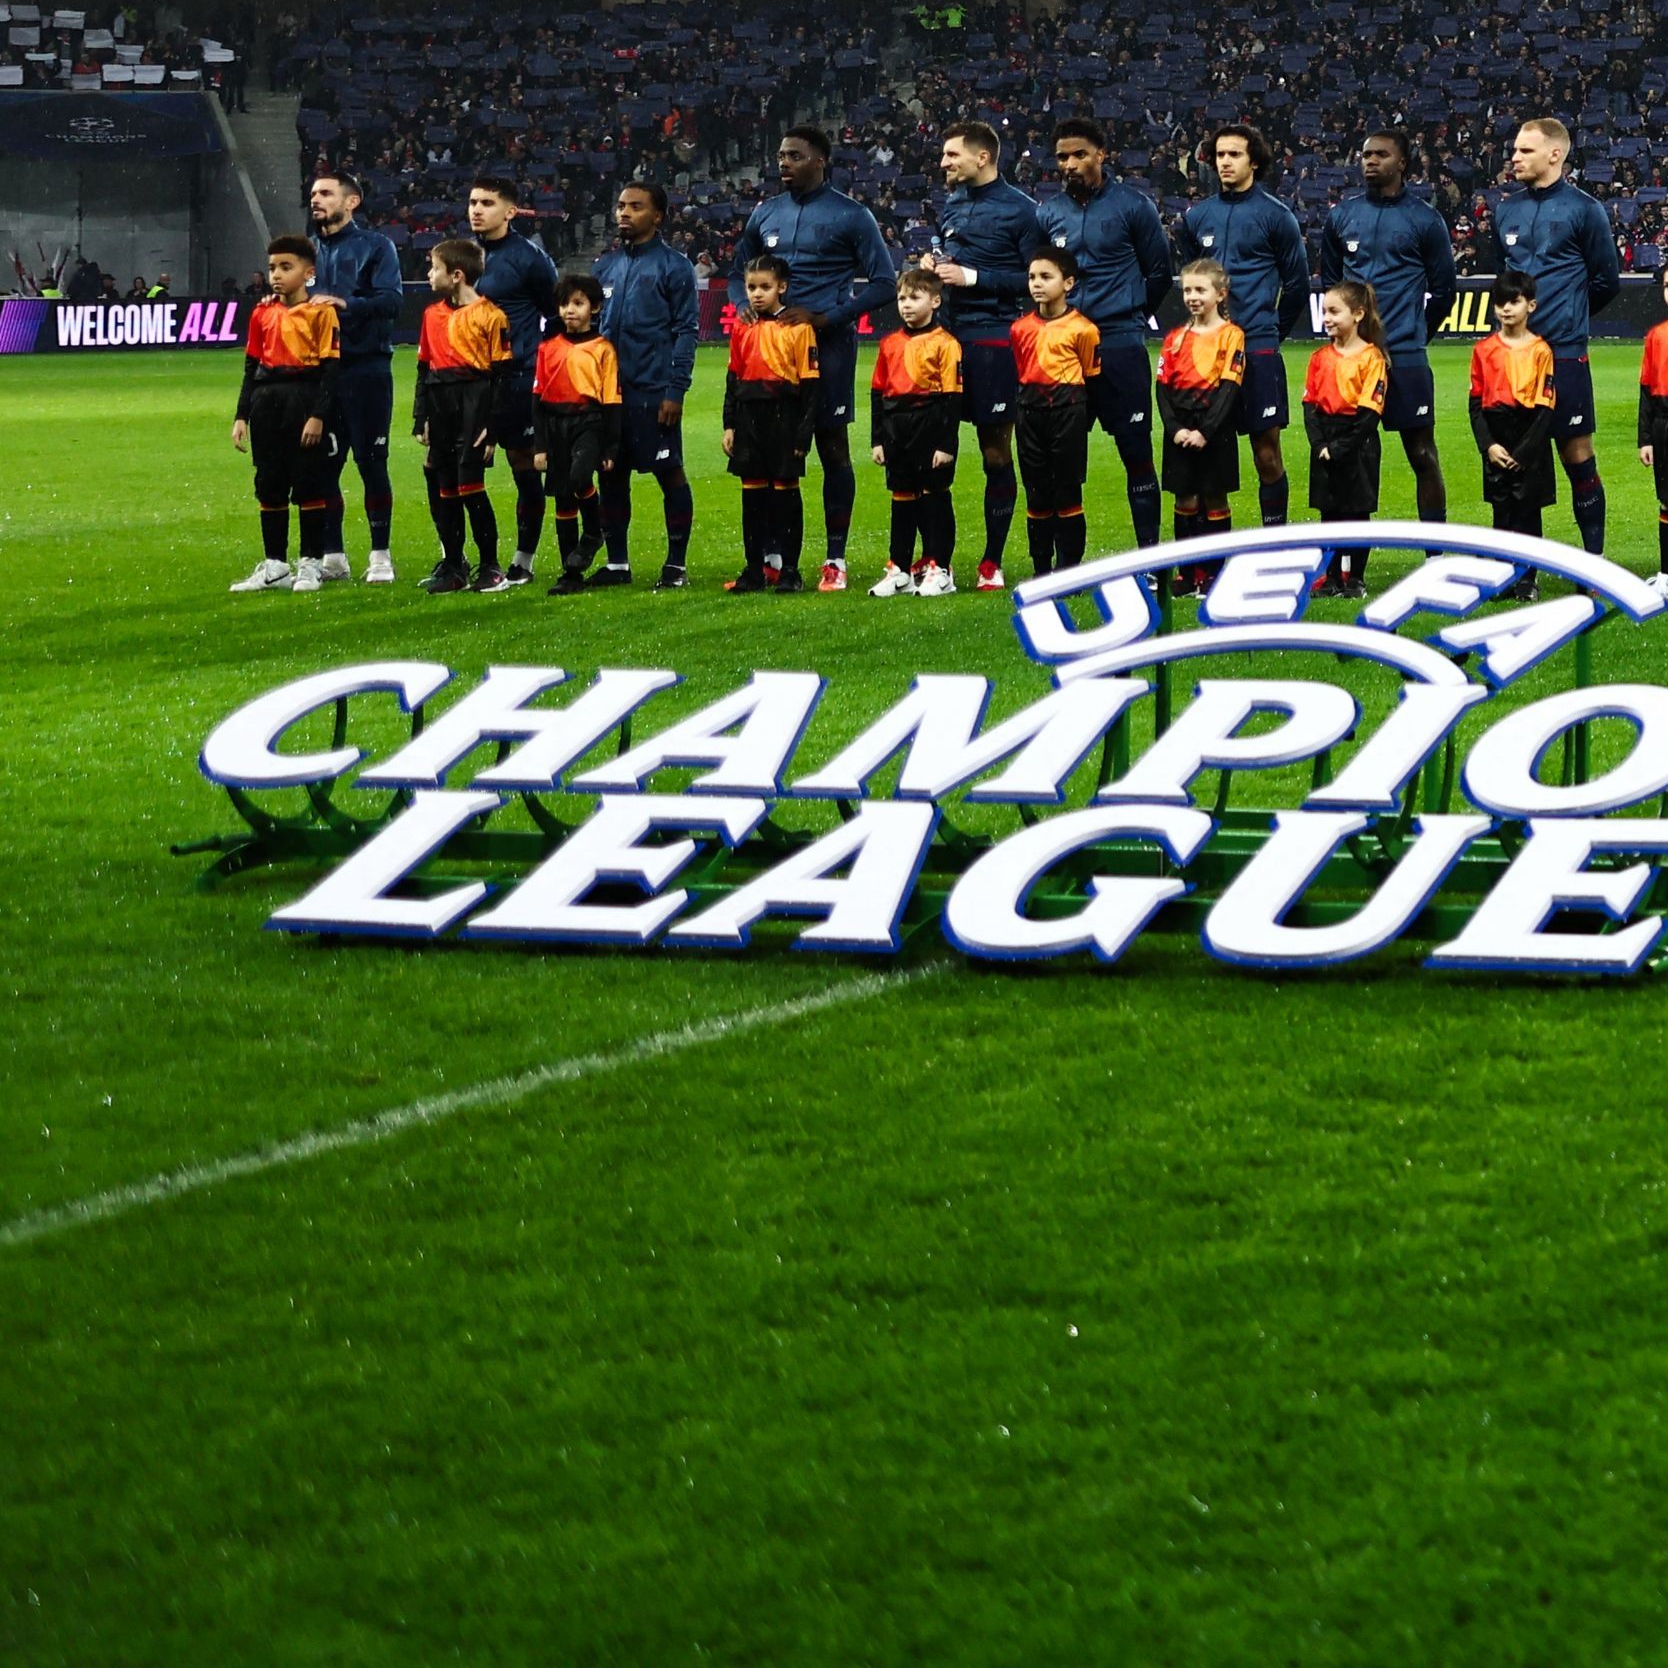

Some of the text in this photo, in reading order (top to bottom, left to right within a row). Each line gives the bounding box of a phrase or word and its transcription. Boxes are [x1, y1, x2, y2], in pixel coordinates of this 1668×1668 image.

[57, 301, 238, 346] WELCOME ALL
[1437, 291, 1492, 332] ALL
[1012, 546, 1601, 686] UEFA
